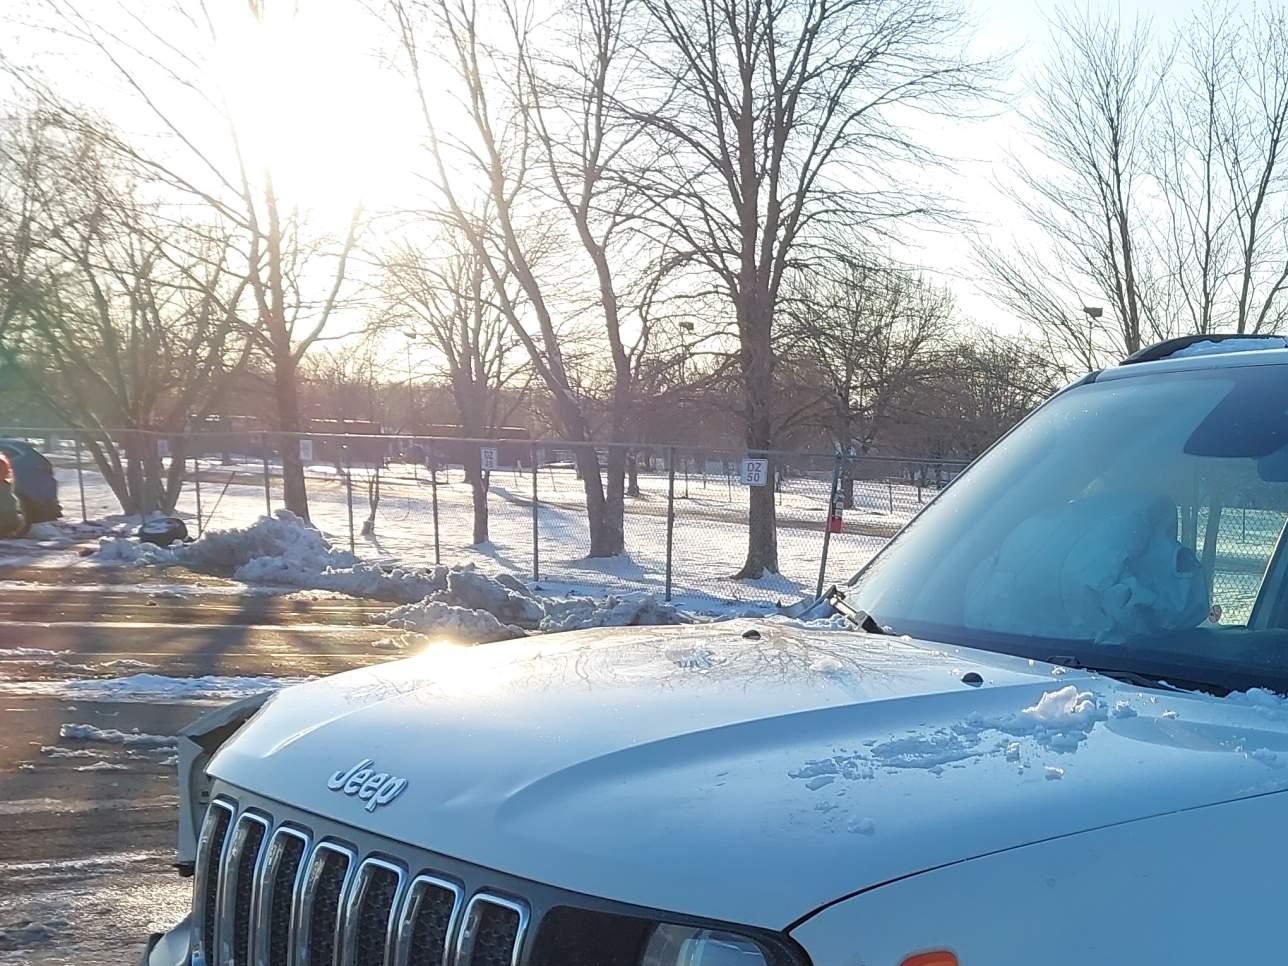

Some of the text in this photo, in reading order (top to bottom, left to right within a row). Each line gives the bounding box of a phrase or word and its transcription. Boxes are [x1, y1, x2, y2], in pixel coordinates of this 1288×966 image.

[747, 462, 762, 473] DZ
[746, 472, 760, 482] 50
[327, 758, 409, 813] Jeep
